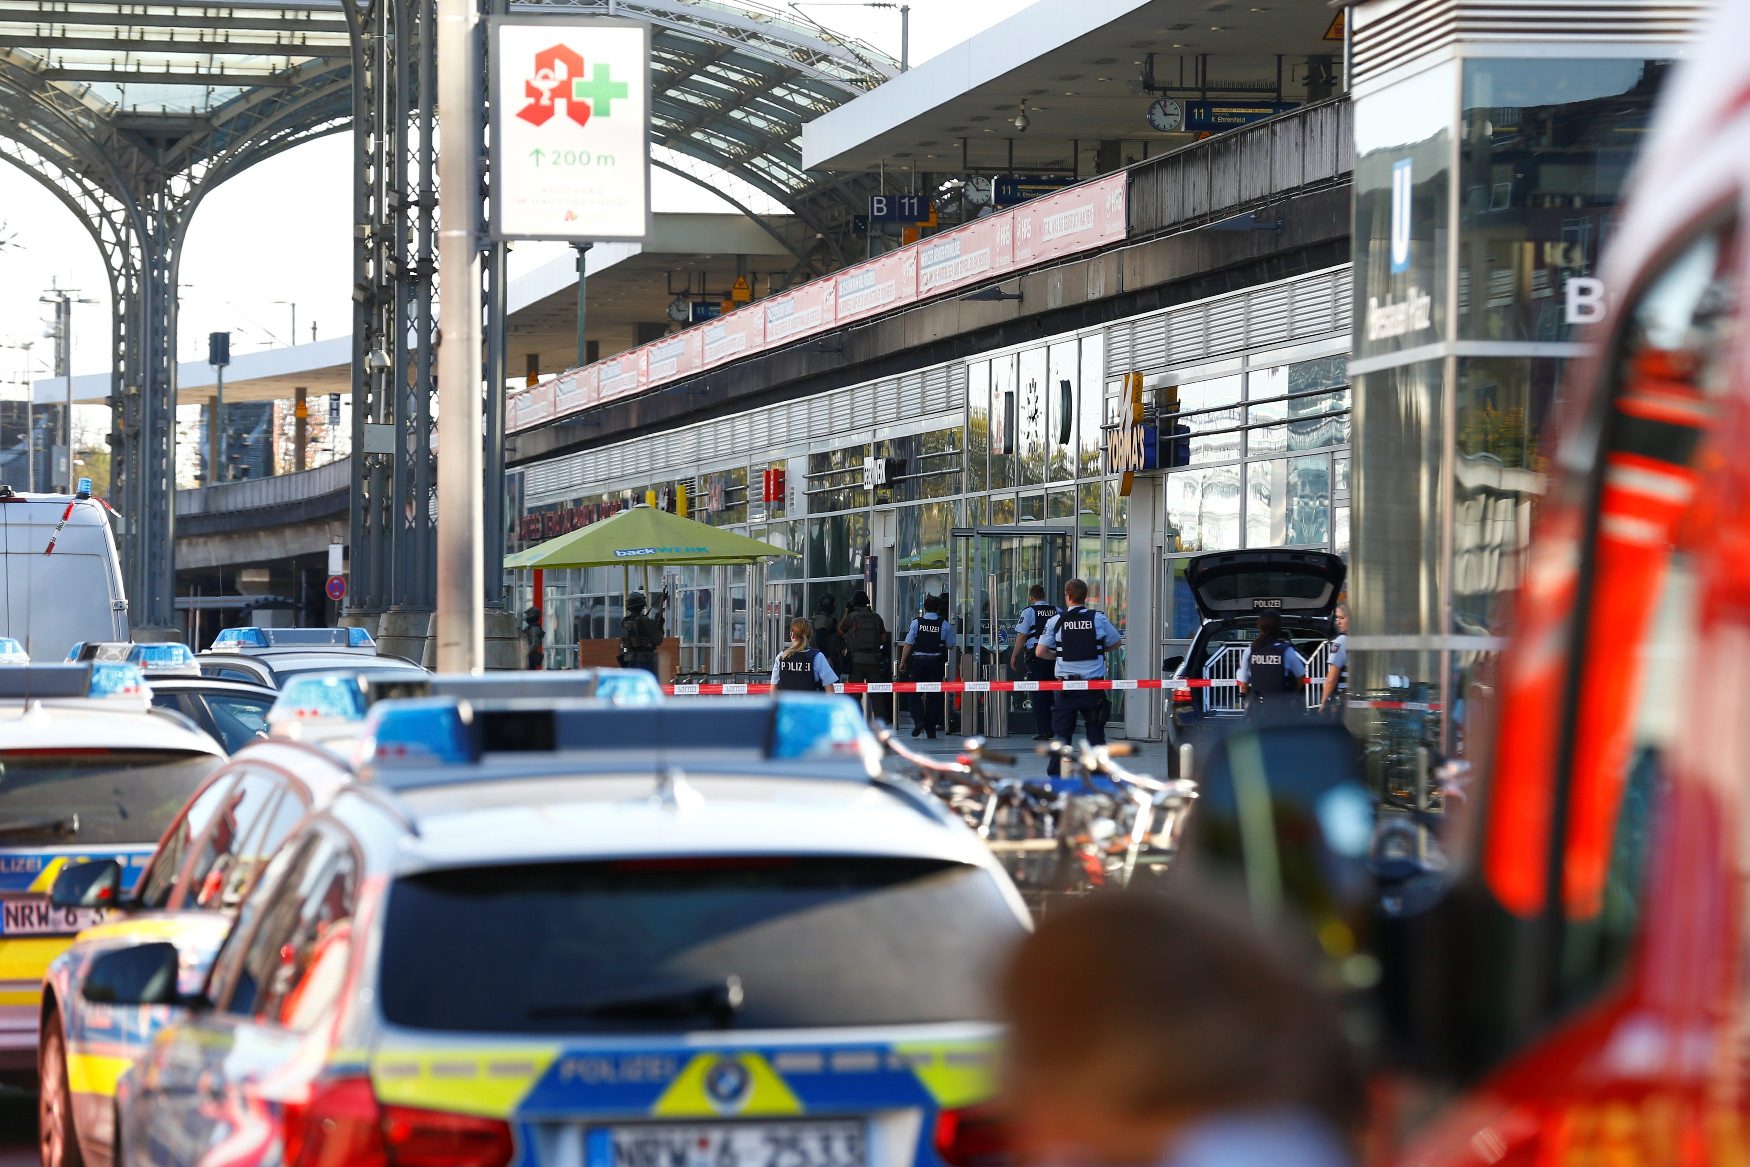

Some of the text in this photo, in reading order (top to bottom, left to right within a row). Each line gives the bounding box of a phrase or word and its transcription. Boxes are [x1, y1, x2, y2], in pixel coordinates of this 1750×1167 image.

[1193, 108, 1204, 119] 11
[552, 150, 615, 166] 200 m
[1001, 185, 1011, 195] 11
[873, 196, 918, 216] B 11
[1254, 600, 1281, 608] POLIZEI
[919, 624, 940, 633] POLIZEI
[1063, 620, 1093, 630] POLIZEI
[1251, 654, 1282, 665] POLIZEI
[5, 905, 49, 928] NRW
[560, 1056, 677, 1085] POLIZEI
